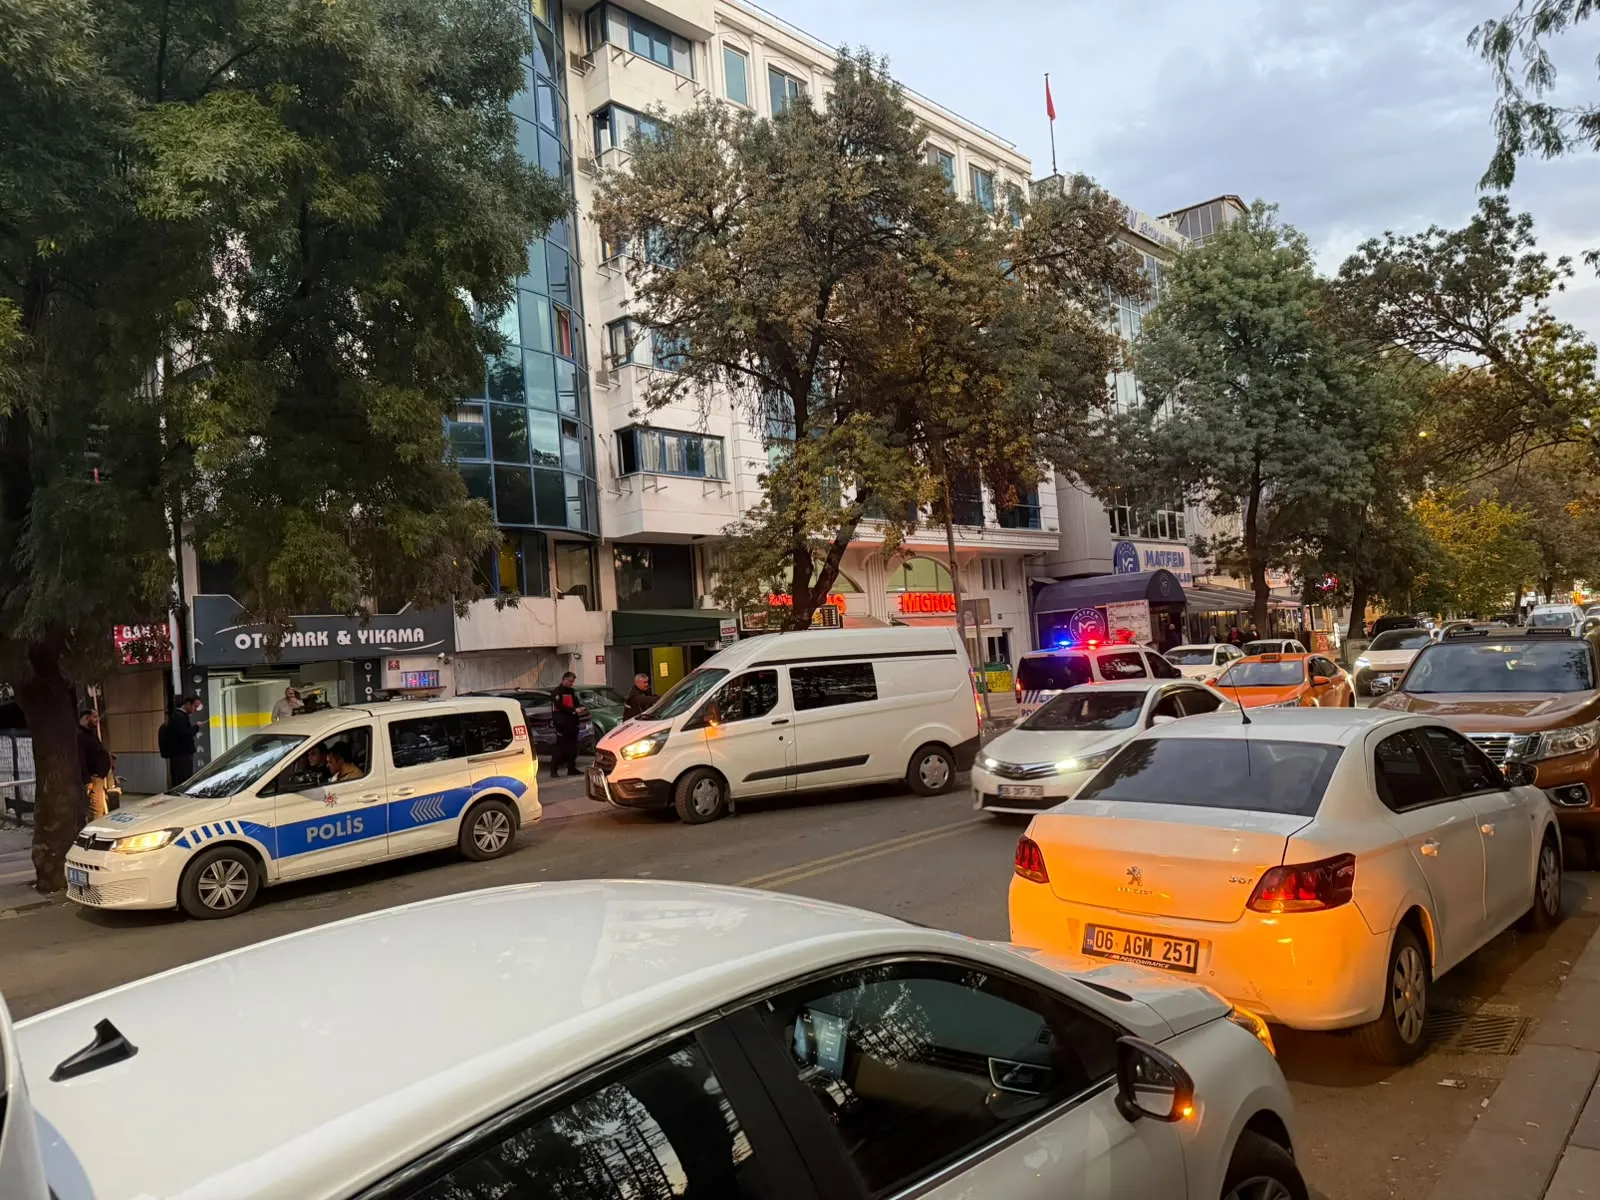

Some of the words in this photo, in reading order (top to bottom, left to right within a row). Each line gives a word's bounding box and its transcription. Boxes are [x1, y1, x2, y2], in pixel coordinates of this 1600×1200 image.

[1145, 550, 1184, 567] MATFEN
[337, 630, 351, 645] &
[357, 628, 425, 644] YIKAMA
[306, 815, 364, 843] POLİS
[1095, 930, 1114, 951] 06
[1123, 934, 1153, 958] AGM
[1162, 941, 1192, 965] 251
